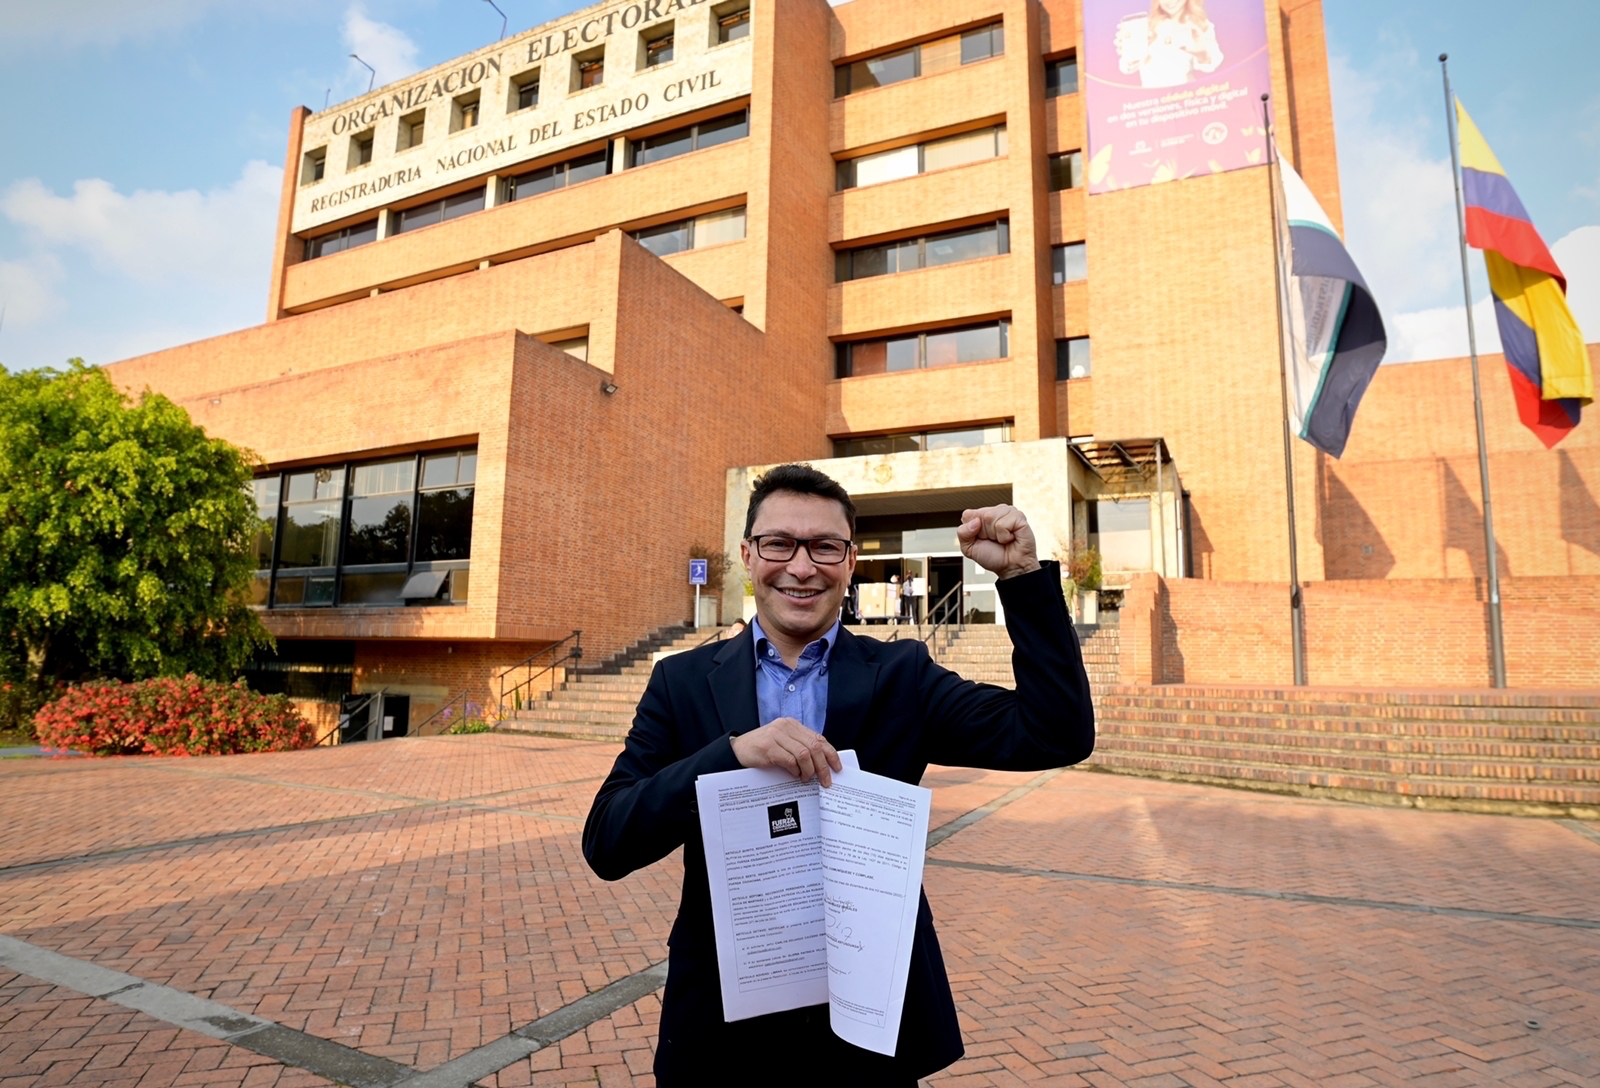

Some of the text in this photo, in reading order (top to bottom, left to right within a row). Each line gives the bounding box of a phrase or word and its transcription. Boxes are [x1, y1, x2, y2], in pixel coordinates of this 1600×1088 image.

[332, 0, 707, 135] ORGANIZACION ELECTORA
[1107, 115, 1119, 123] en
[1120, 110, 1137, 121] dos
[1210, 95, 1217, 106] y
[1218, 87, 1249, 101] digital
[1122, 98, 1159, 111] Nuestra
[1195, 81, 1230, 97] digital
[1125, 119, 1137, 128] en
[1139, 117, 1149, 126] tu
[1151, 106, 1199, 124] dispositivo
[311, 70, 721, 213] REGISTRADURIA NACIONAL DEL ESTADO CIVIL
[771, 817, 797, 827] FUERZA
